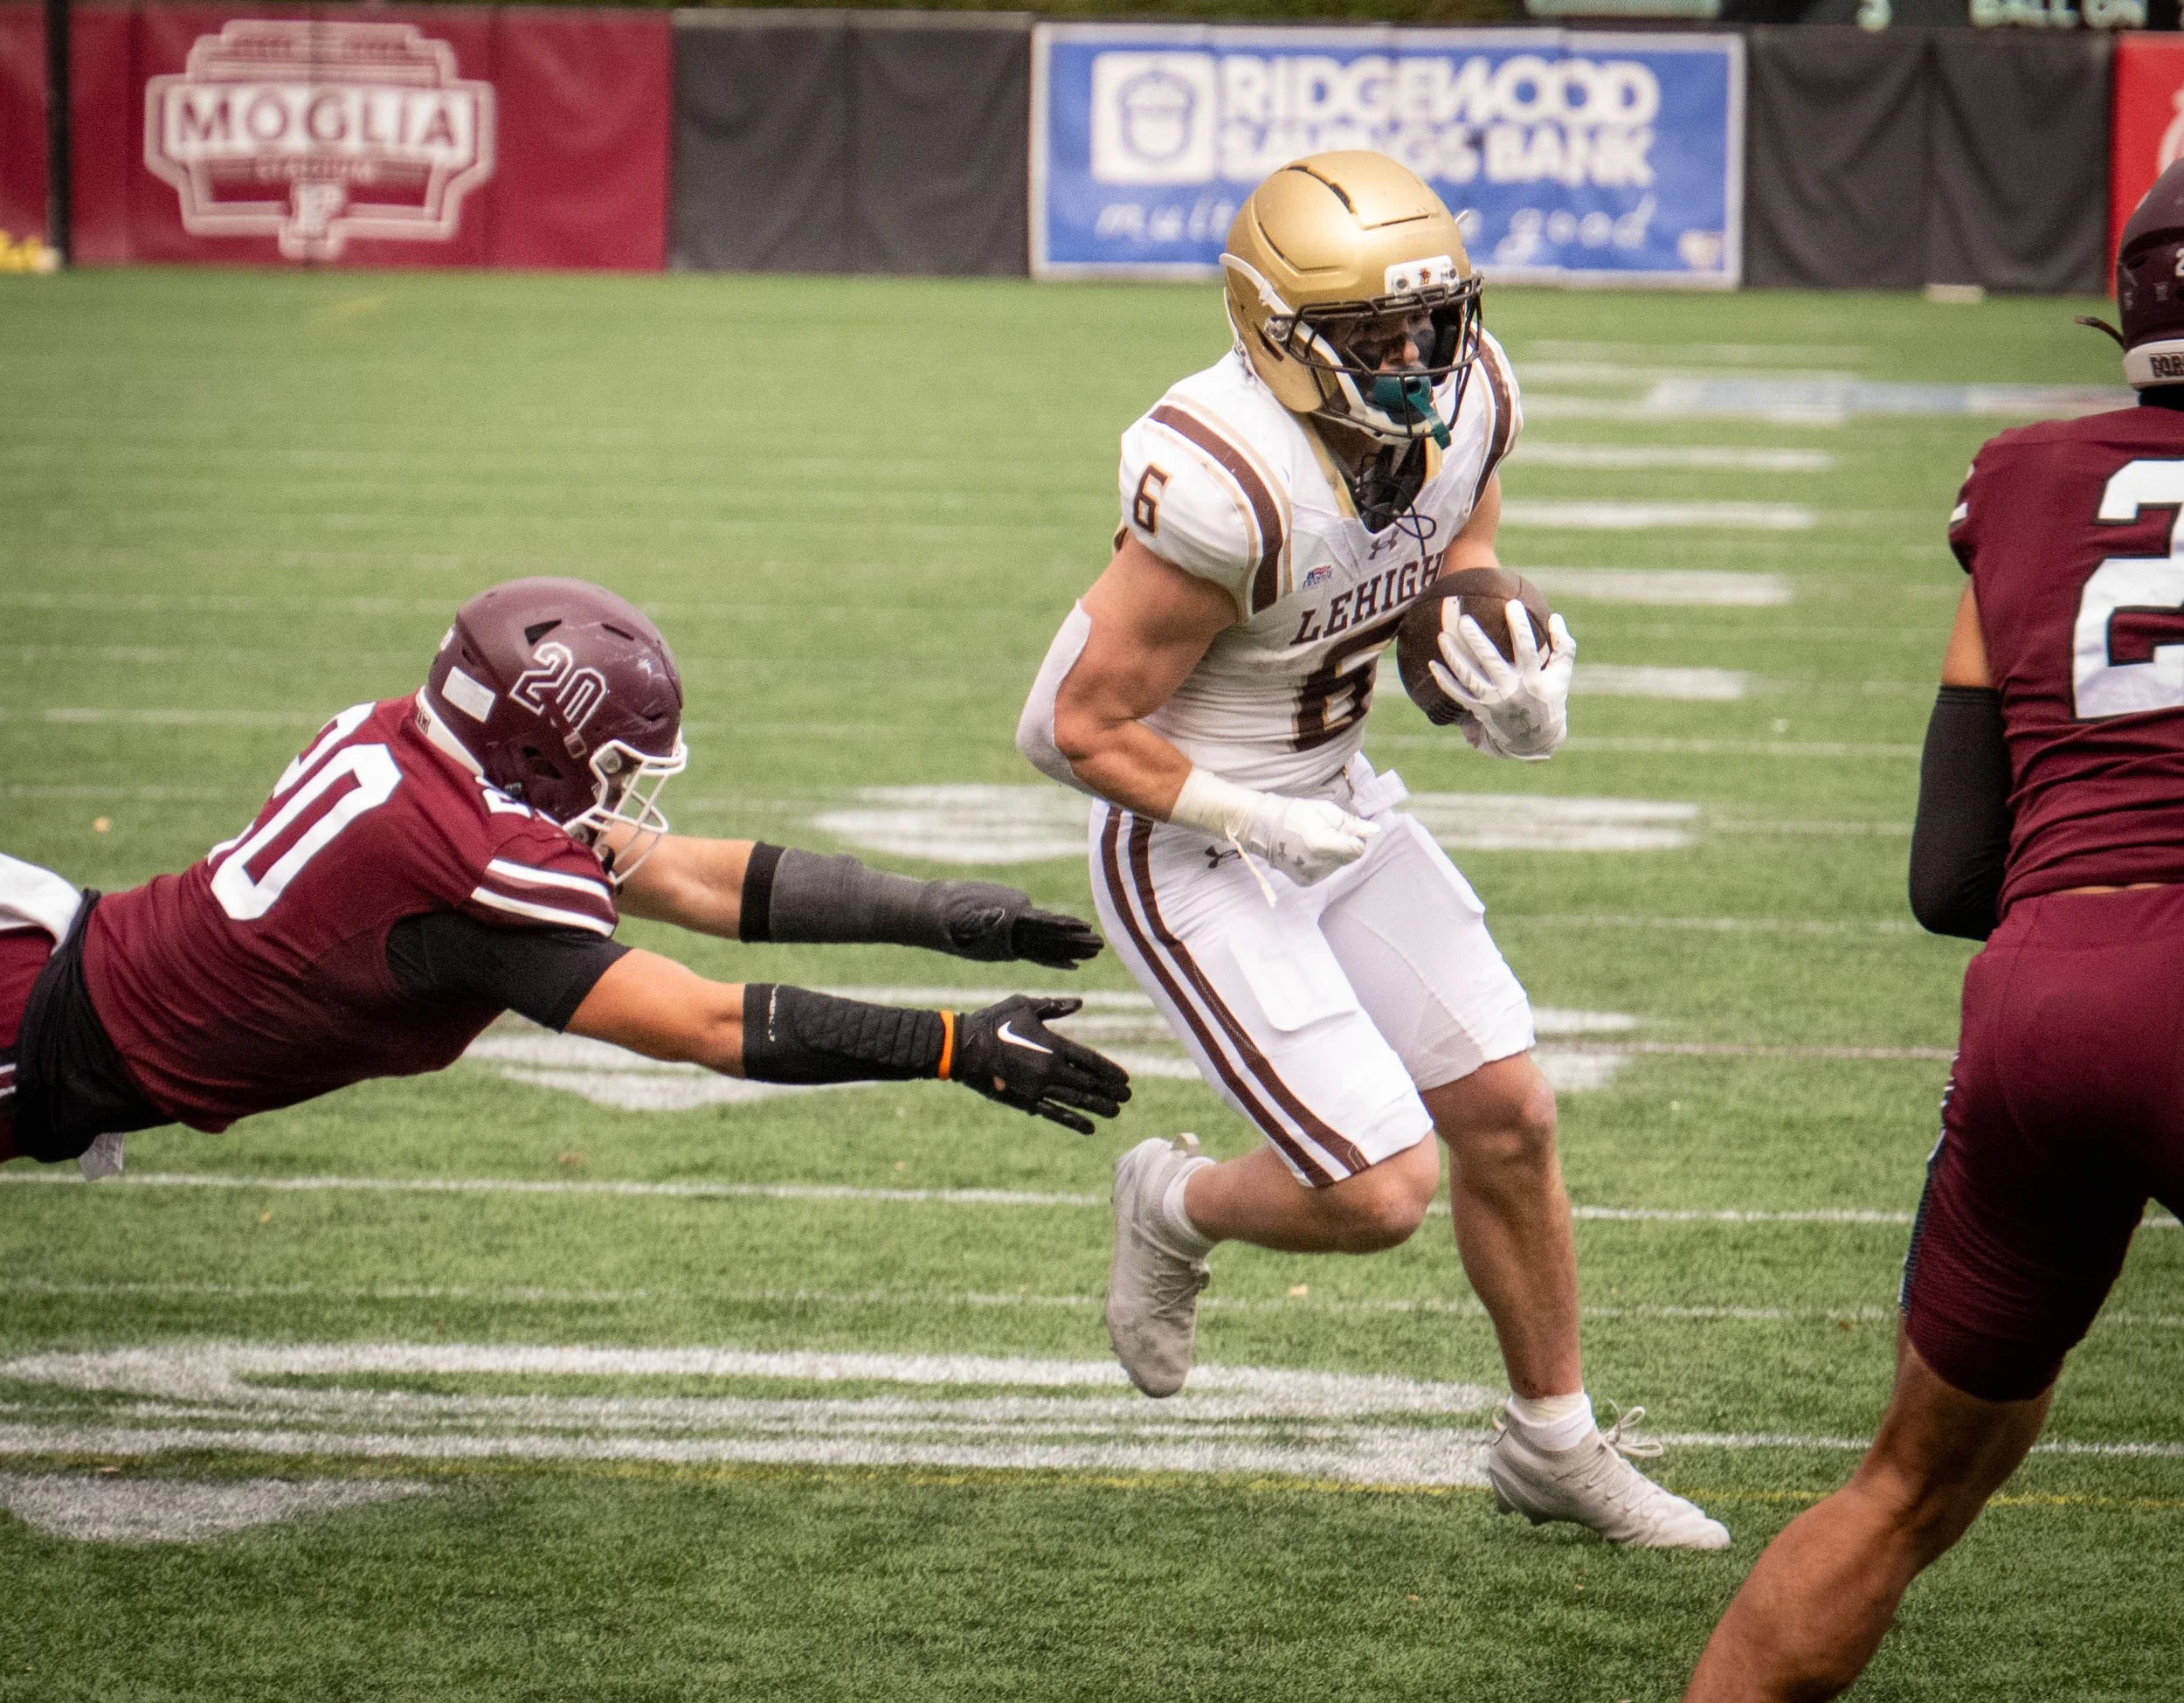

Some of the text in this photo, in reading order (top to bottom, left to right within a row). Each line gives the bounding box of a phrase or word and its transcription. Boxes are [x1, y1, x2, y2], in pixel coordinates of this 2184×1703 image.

[178, 94, 456, 149] MOGLIA
[1221, 55, 1661, 127] RIDGEWOOD
[1484, 122, 1654, 185] BANK
[1133, 463, 1171, 535] 6
[1289, 551, 1444, 646] LEHIGH
[509, 641, 607, 735] 20
[1293, 610, 1405, 753] 6
